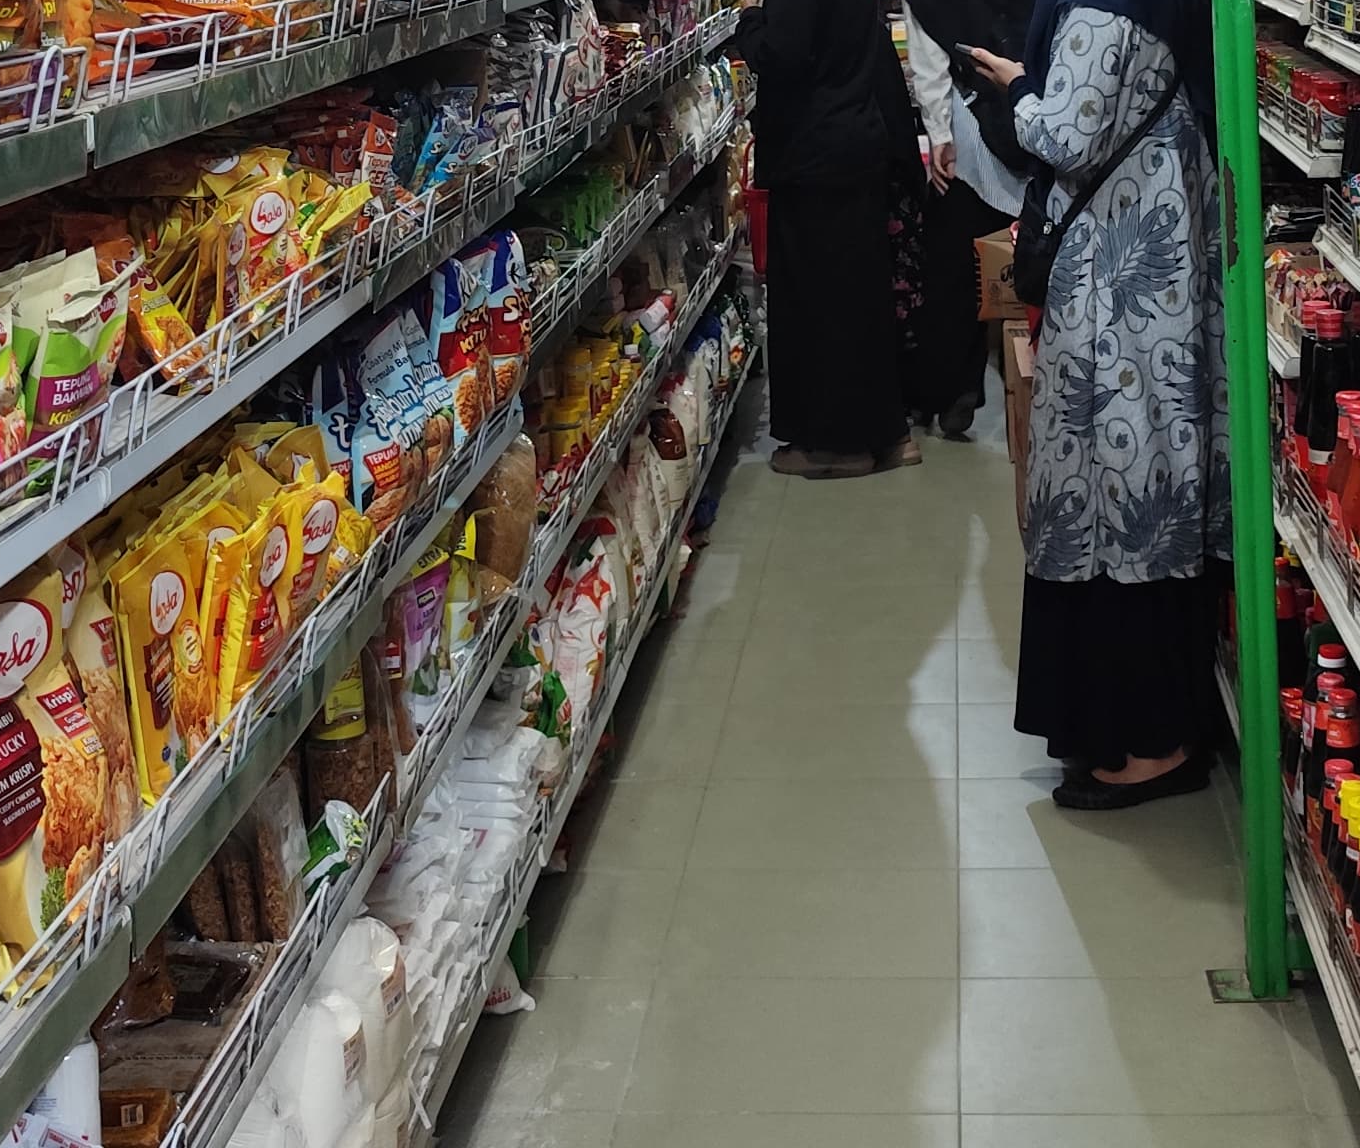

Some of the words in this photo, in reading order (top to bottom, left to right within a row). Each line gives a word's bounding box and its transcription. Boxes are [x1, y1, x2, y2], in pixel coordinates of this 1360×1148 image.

[367, 154, 391, 169] Tepun
[48, 406, 76, 427] Kris
[301, 512, 334, 543] Sasa
[44, 686, 76, 710] Krispi
[7, 760, 37, 788] KRISPI
